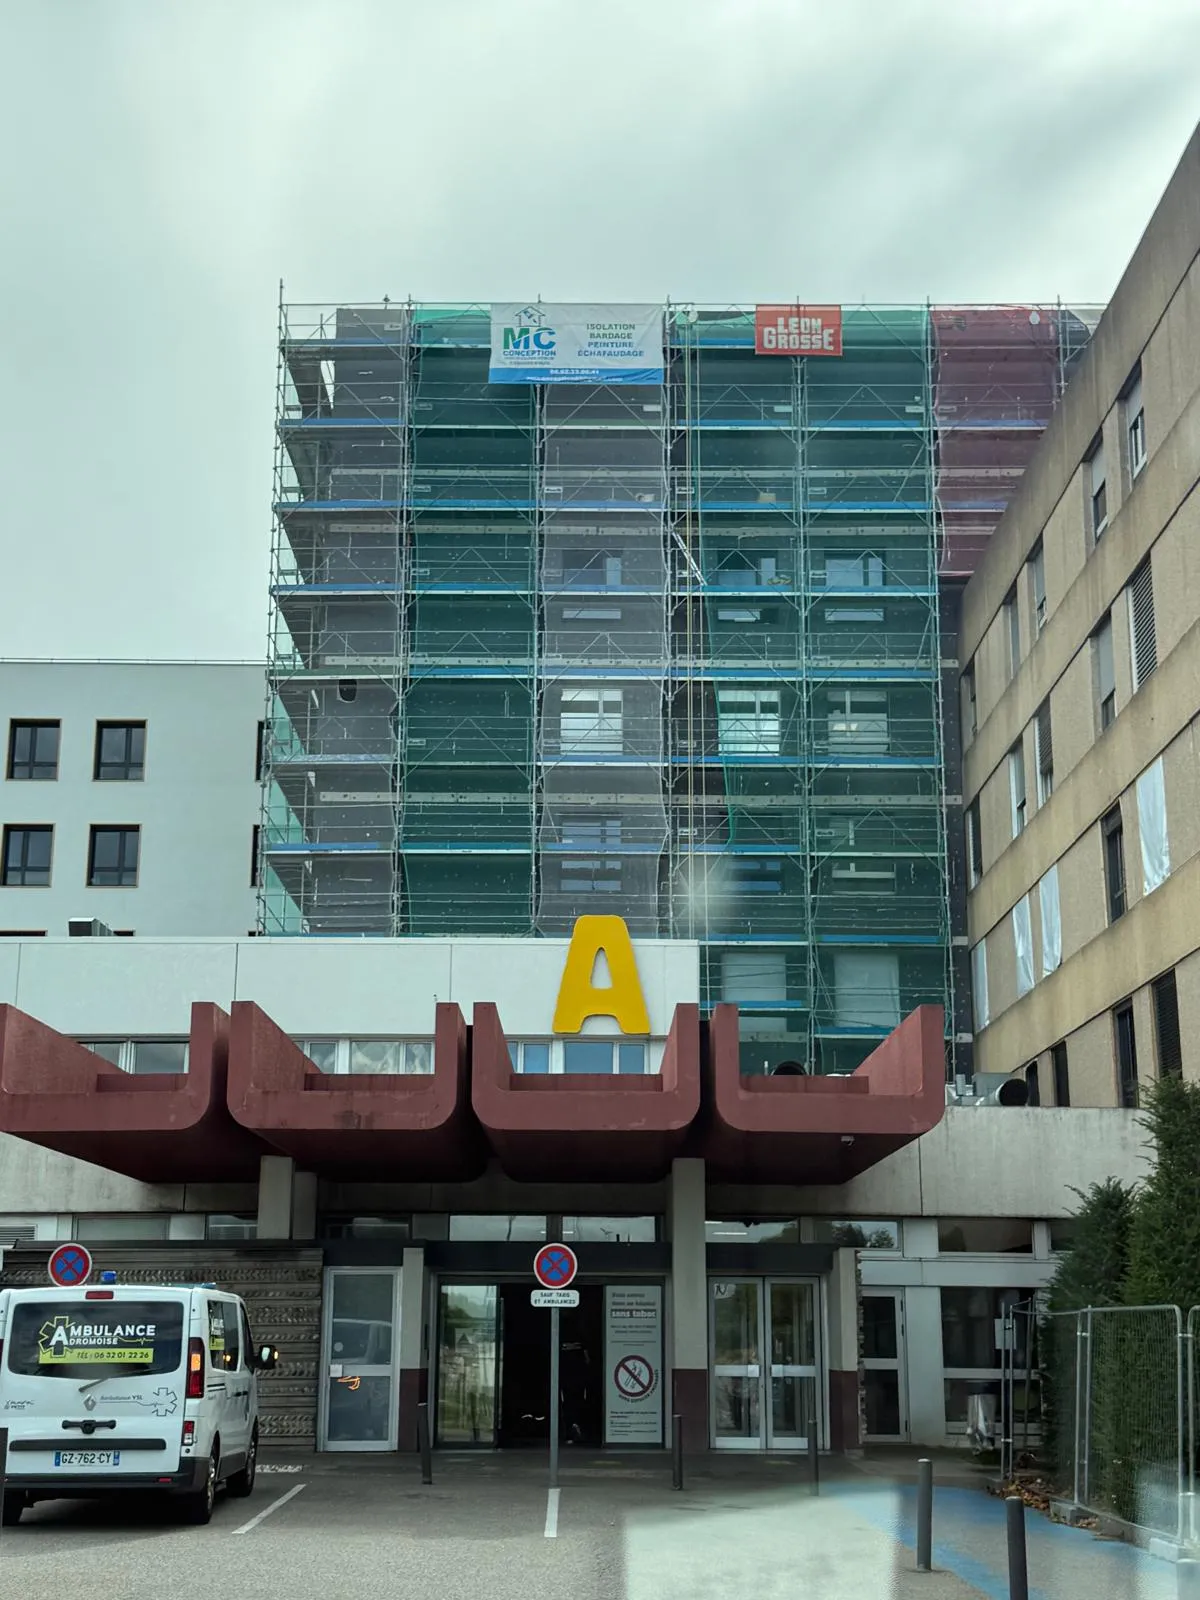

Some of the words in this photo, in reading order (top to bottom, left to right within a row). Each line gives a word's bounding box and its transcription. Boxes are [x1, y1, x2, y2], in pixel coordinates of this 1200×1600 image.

[587, 323, 635, 331] ISOLATION
[777, 317, 821, 333] LEON
[503, 327, 556, 350] MC
[763, 327, 834, 351] GROSSE
[552, 915, 651, 1035] A
[49, 1325, 156, 1346] AMBULANCE
[62, 1453, 111, 1464] GZ-762-CY
